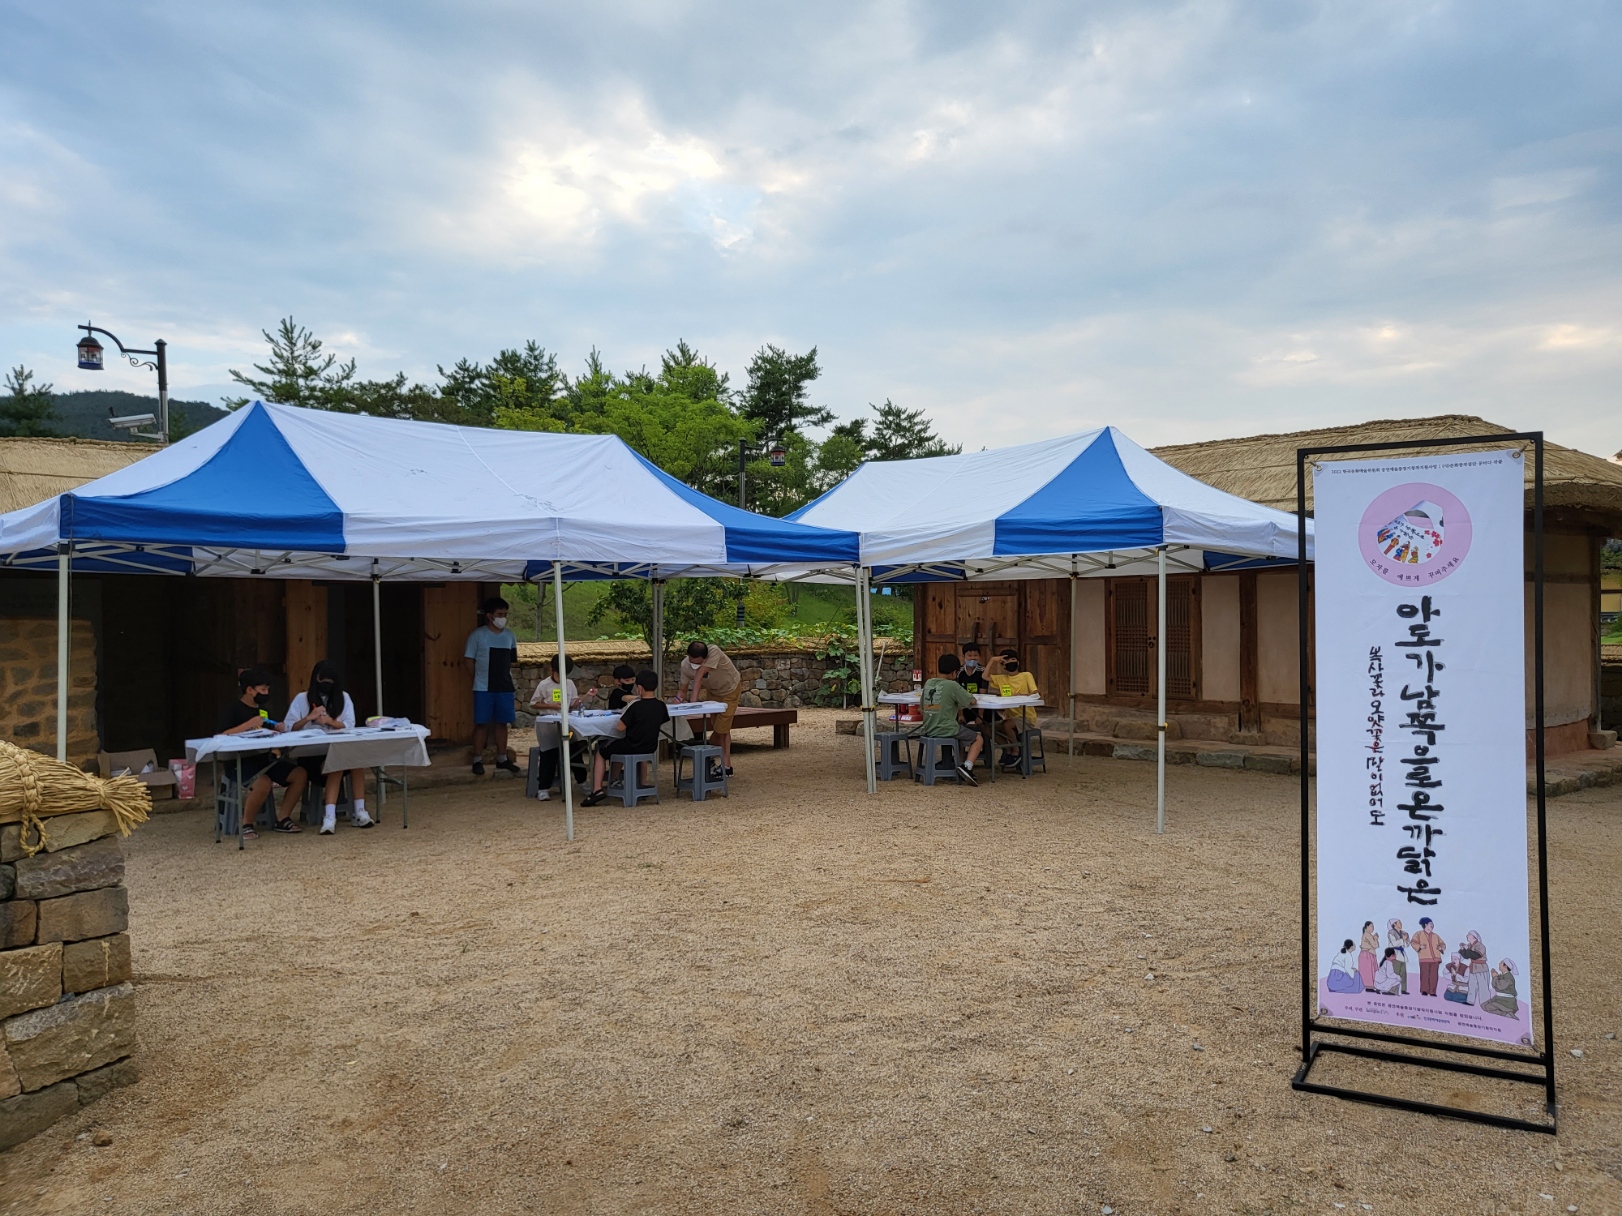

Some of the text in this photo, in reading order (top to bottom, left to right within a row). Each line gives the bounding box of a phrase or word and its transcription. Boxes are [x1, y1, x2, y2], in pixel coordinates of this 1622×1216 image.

[1369, 556, 1460, 582] 모자를 예쁘게 꾸며주세요
[1394, 595, 1445, 684] 아도가
[1397, 684, 1446, 789] 남쪽으로
[1396, 823, 1446, 906] 까닭은
